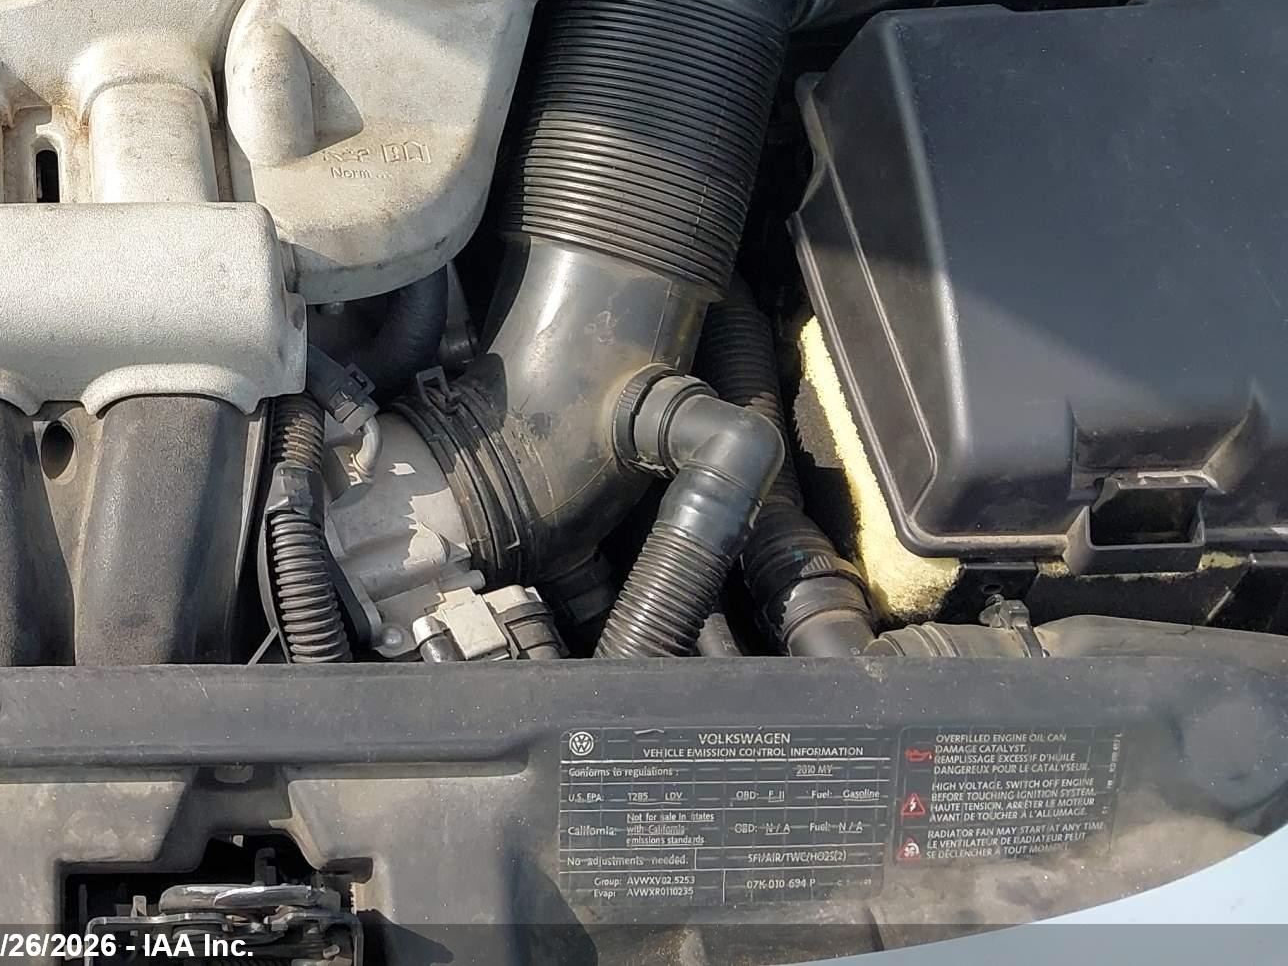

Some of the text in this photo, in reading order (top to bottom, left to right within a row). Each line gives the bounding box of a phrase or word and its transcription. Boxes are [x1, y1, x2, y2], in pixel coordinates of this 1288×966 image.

[329, 166, 371, 179] Norm
[698, 732, 791, 745] VOLKSWAGEN
[935, 733, 1067, 743] OVERFILLED ENGINE OIL CAN
[643, 746, 864, 758] VEHICLE EMISSION CONTROL INFORMATION
[934, 744, 1027, 754] DAMAGE CATALYST.
[568, 766, 610, 777] Conforms
[613, 766, 622, 777] to
[624, 766, 673, 778] regulations
[933, 765, 990, 774] DANGEREUX
[992, 764, 1017, 774] POUR
[931, 782, 957, 791] HIGH
[1005, 779, 1041, 790] SWITCH
[1042, 779, 1060, 789] OFF
[1061, 778, 1095, 788] ENGINE
[811, 788, 880, 800] Fuel: Gasoline
[931, 792, 964, 802] BEFORE
[967, 790, 1015, 801] TOUCHING
[1016, 789, 1058, 799] IGNITION
[930, 802, 961, 812] HAUTE
[1056, 796, 1096, 808] MOTEUR
[626, 813, 642, 821] Not
[645, 813, 657, 821] for
[678, 812, 686, 820] in
[929, 812, 961, 823] AVANT
[964, 812, 975, 822] DE
[978, 811, 1018, 821] TOUCHER
[927, 829, 974, 839] RADIATOR
[975, 827, 994, 837] FAN
[996, 826, 1017, 836] MAY
[1020, 824, 1047, 834] START
[1061, 822, 1081, 832] ANY
[1083, 821, 1104, 831] TIME
[626, 835, 705, 845] emissions standards
[926, 839, 938, 850] LE
[1000, 836, 1012, 846] DE
[567, 856, 581, 866] No
[587, 855, 645, 867] adjustments
